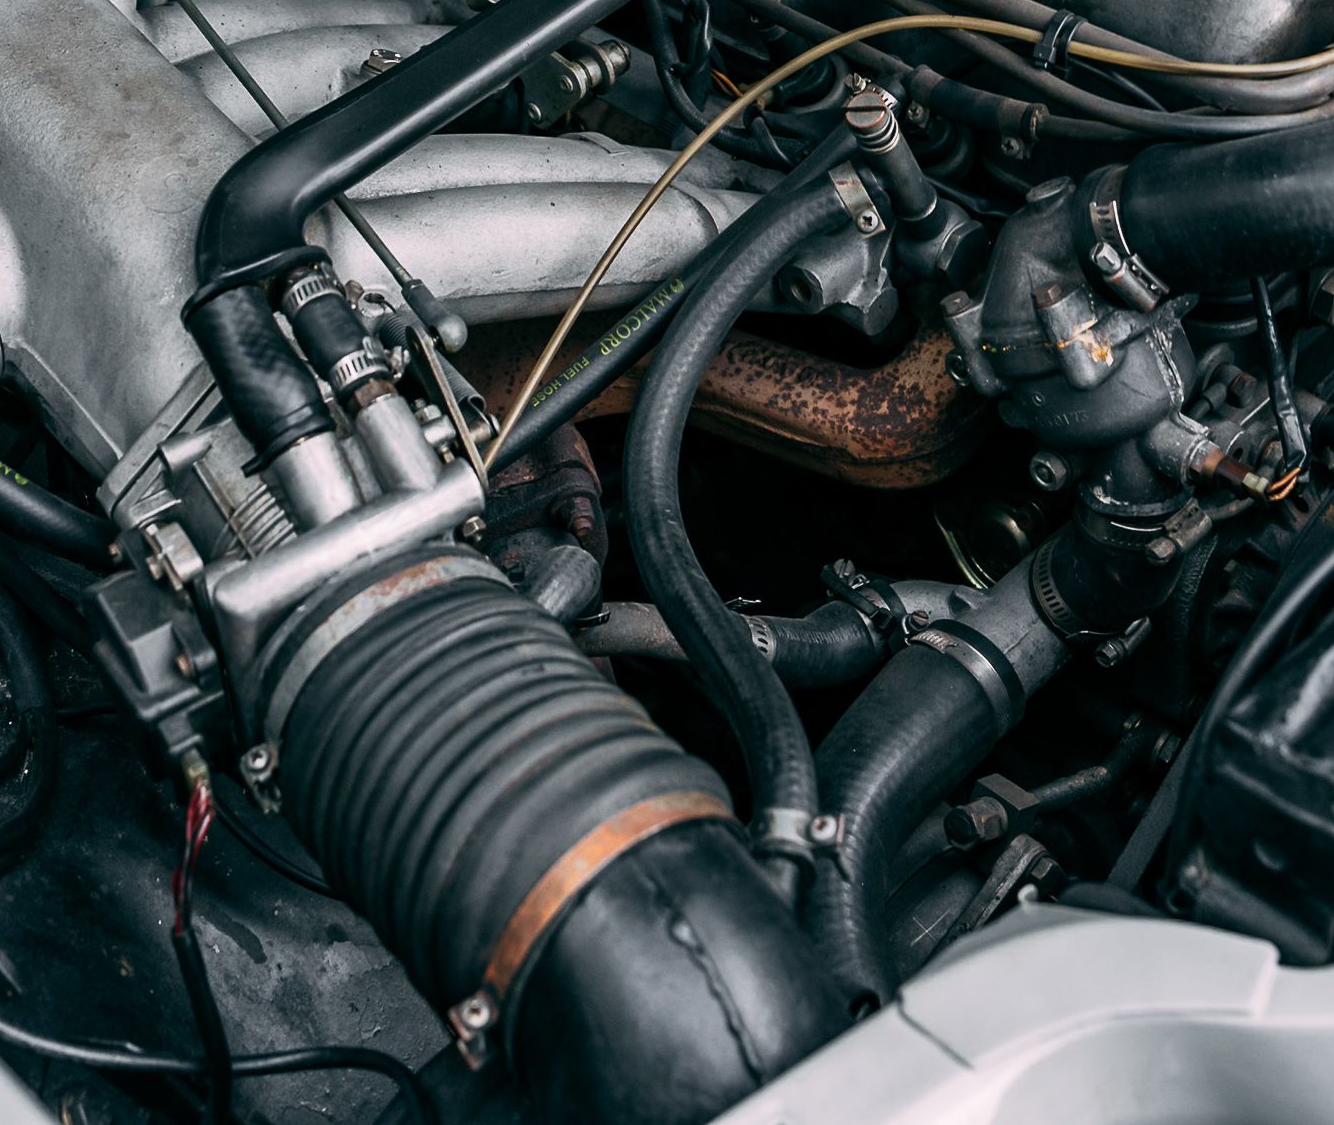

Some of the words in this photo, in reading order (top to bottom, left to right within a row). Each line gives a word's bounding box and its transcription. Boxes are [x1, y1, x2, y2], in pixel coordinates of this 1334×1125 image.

[600, 288, 673, 356] MALCORP
[564, 356, 591, 380] FUEL
[530, 379, 563, 408] HOSE
